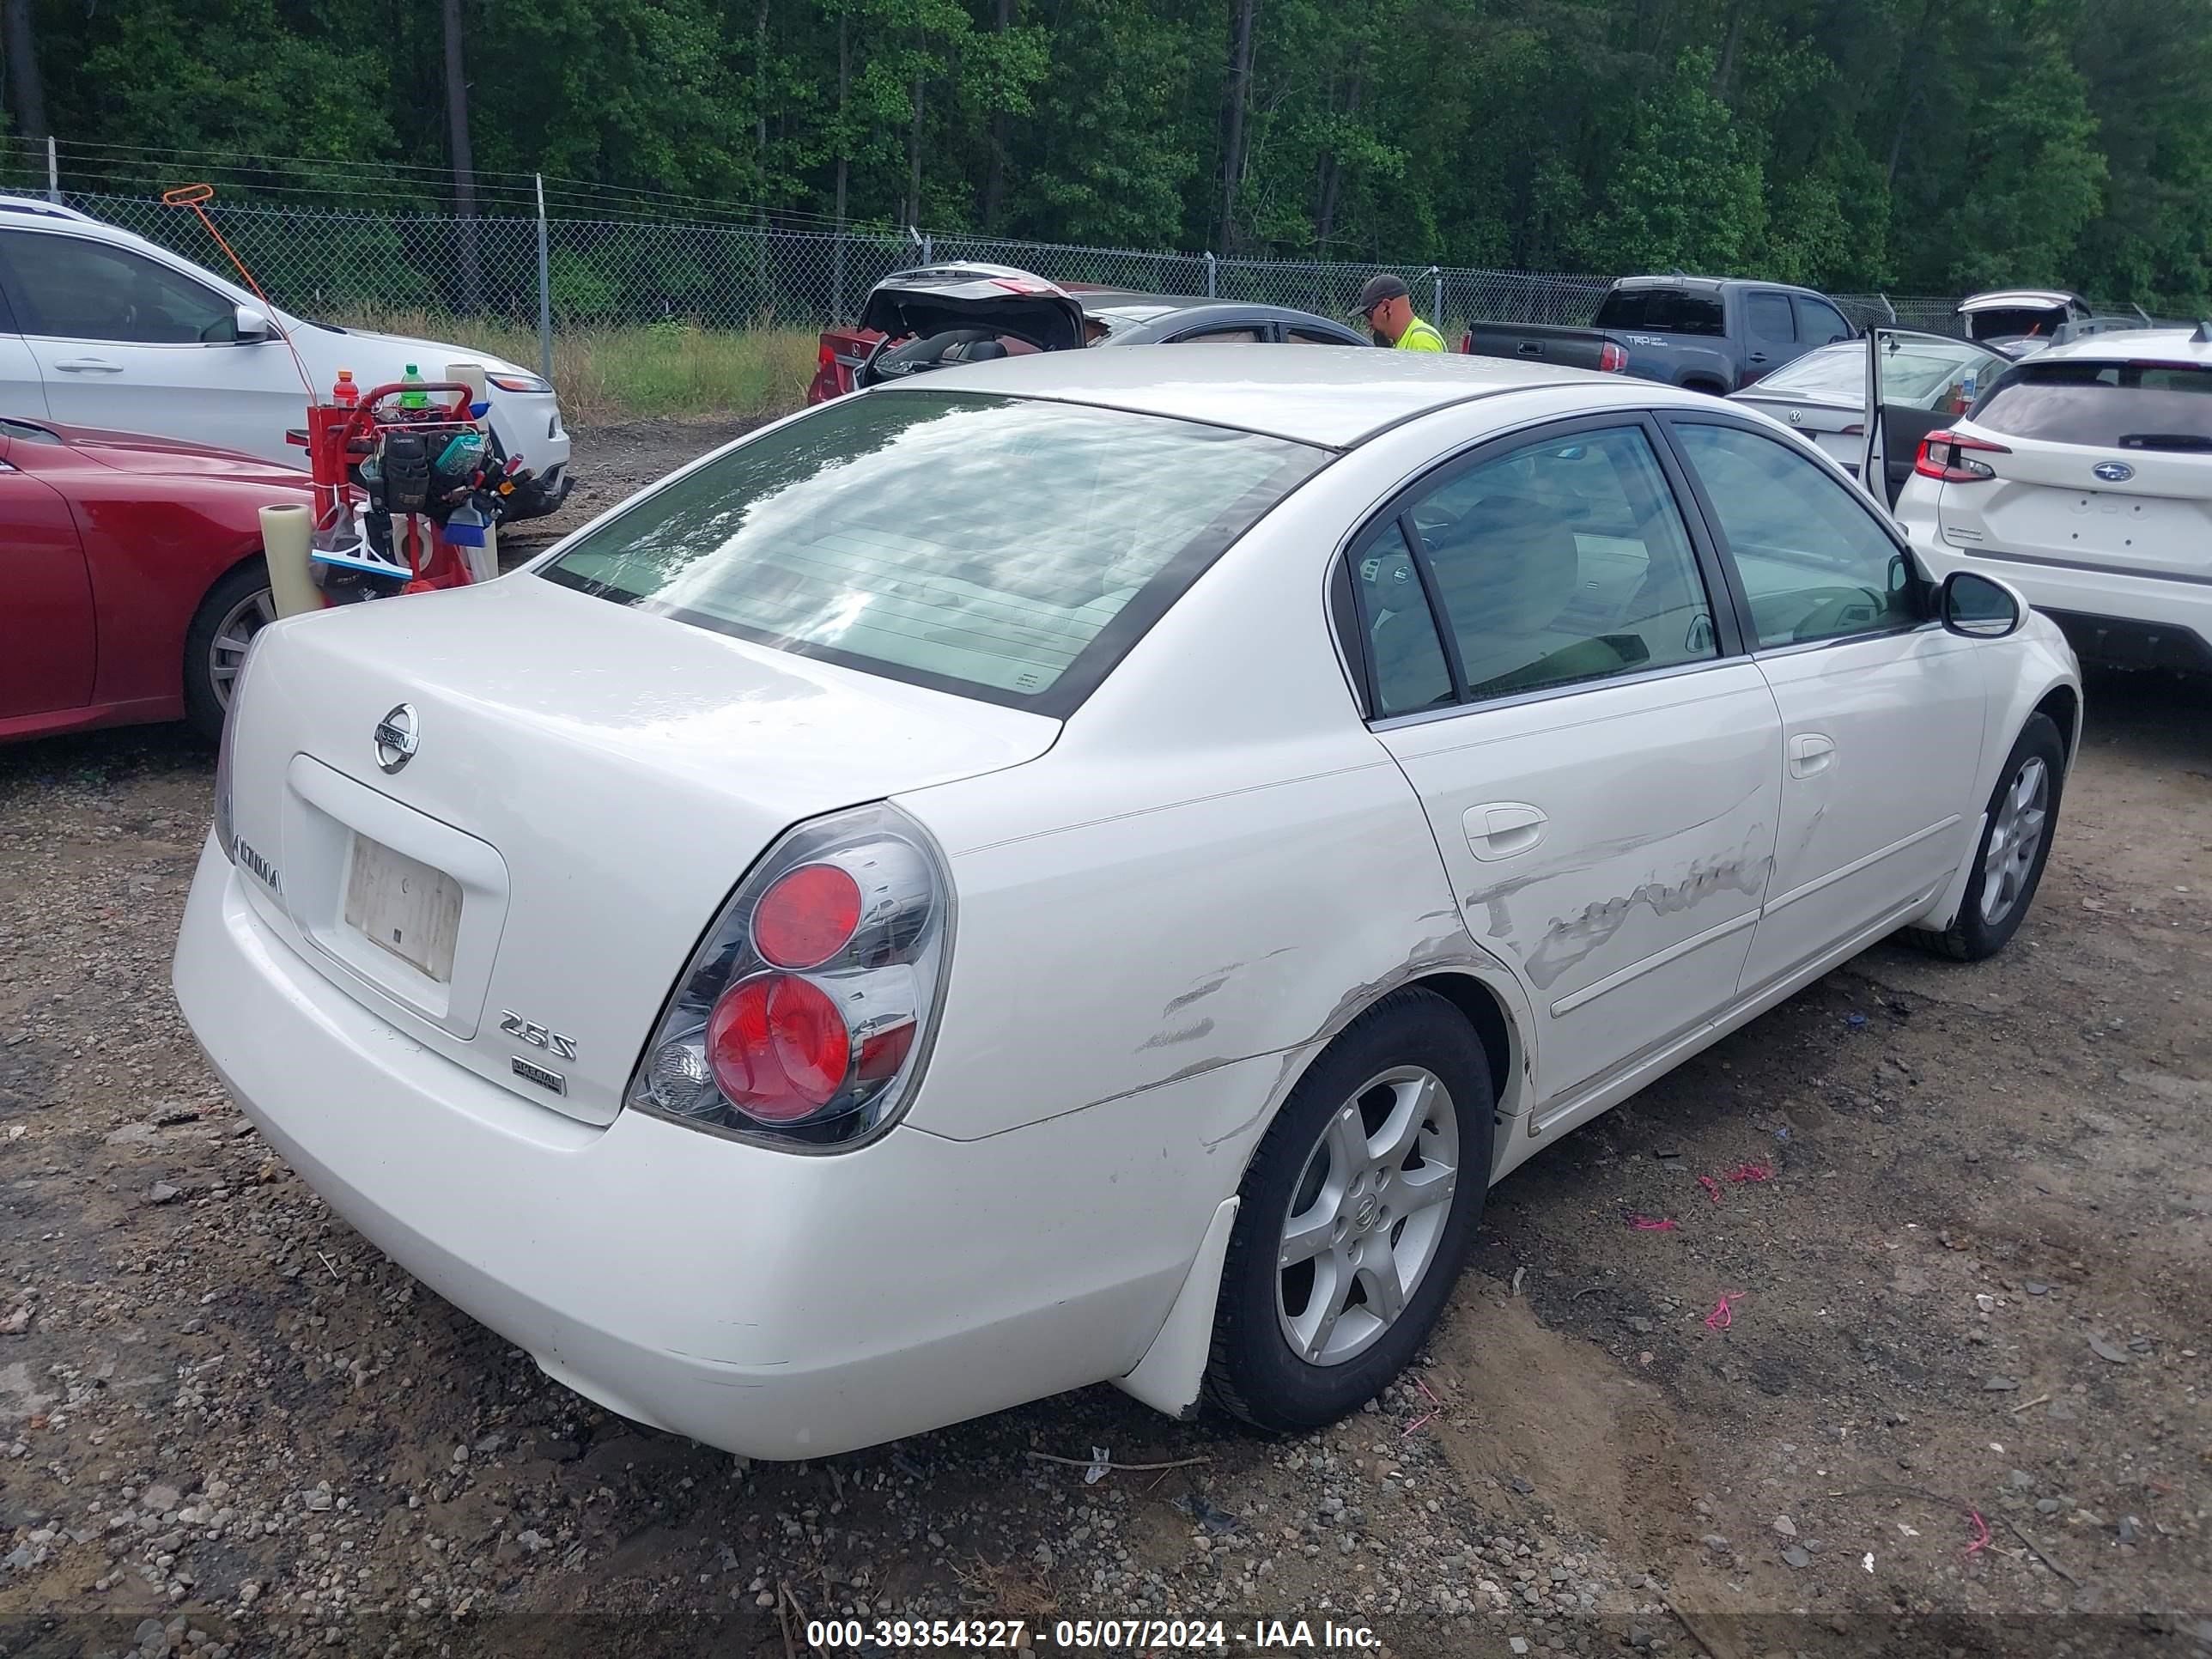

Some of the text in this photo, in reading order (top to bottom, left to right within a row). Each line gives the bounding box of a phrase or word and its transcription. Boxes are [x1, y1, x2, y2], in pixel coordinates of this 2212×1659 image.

[377, 727, 410, 749] NISSAN
[233, 834, 283, 896] ALTIMA
[514, 1059, 561, 1087] SPECIAL
